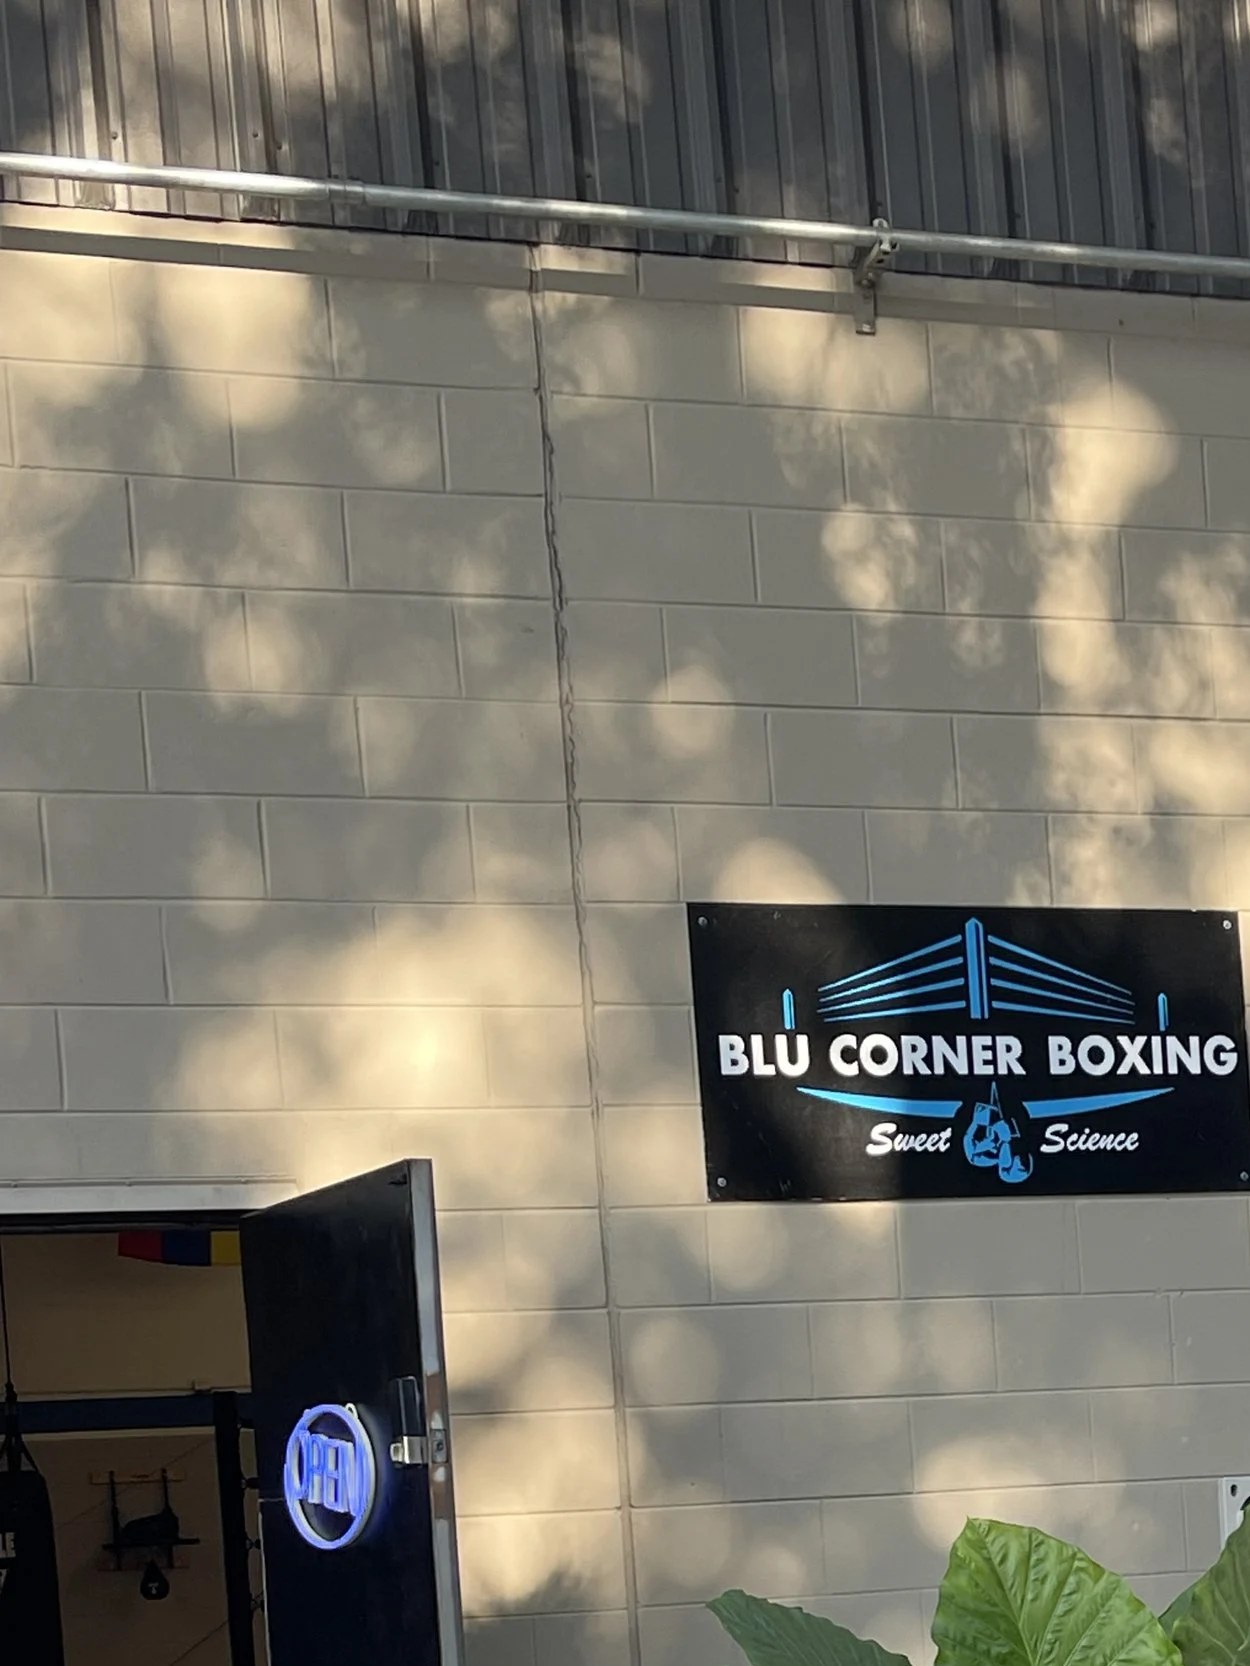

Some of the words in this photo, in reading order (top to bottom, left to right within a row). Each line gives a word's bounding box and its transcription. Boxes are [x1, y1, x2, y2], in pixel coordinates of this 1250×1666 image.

[718, 1033, 810, 1077] BLU
[828, 1033, 1027, 1077] CORNER
[1047, 1034, 1239, 1076] BOXING
[866, 1122, 953, 1156] Sweet
[1039, 1123, 1140, 1153] Science
[285, 1428, 370, 1518] OPEN
